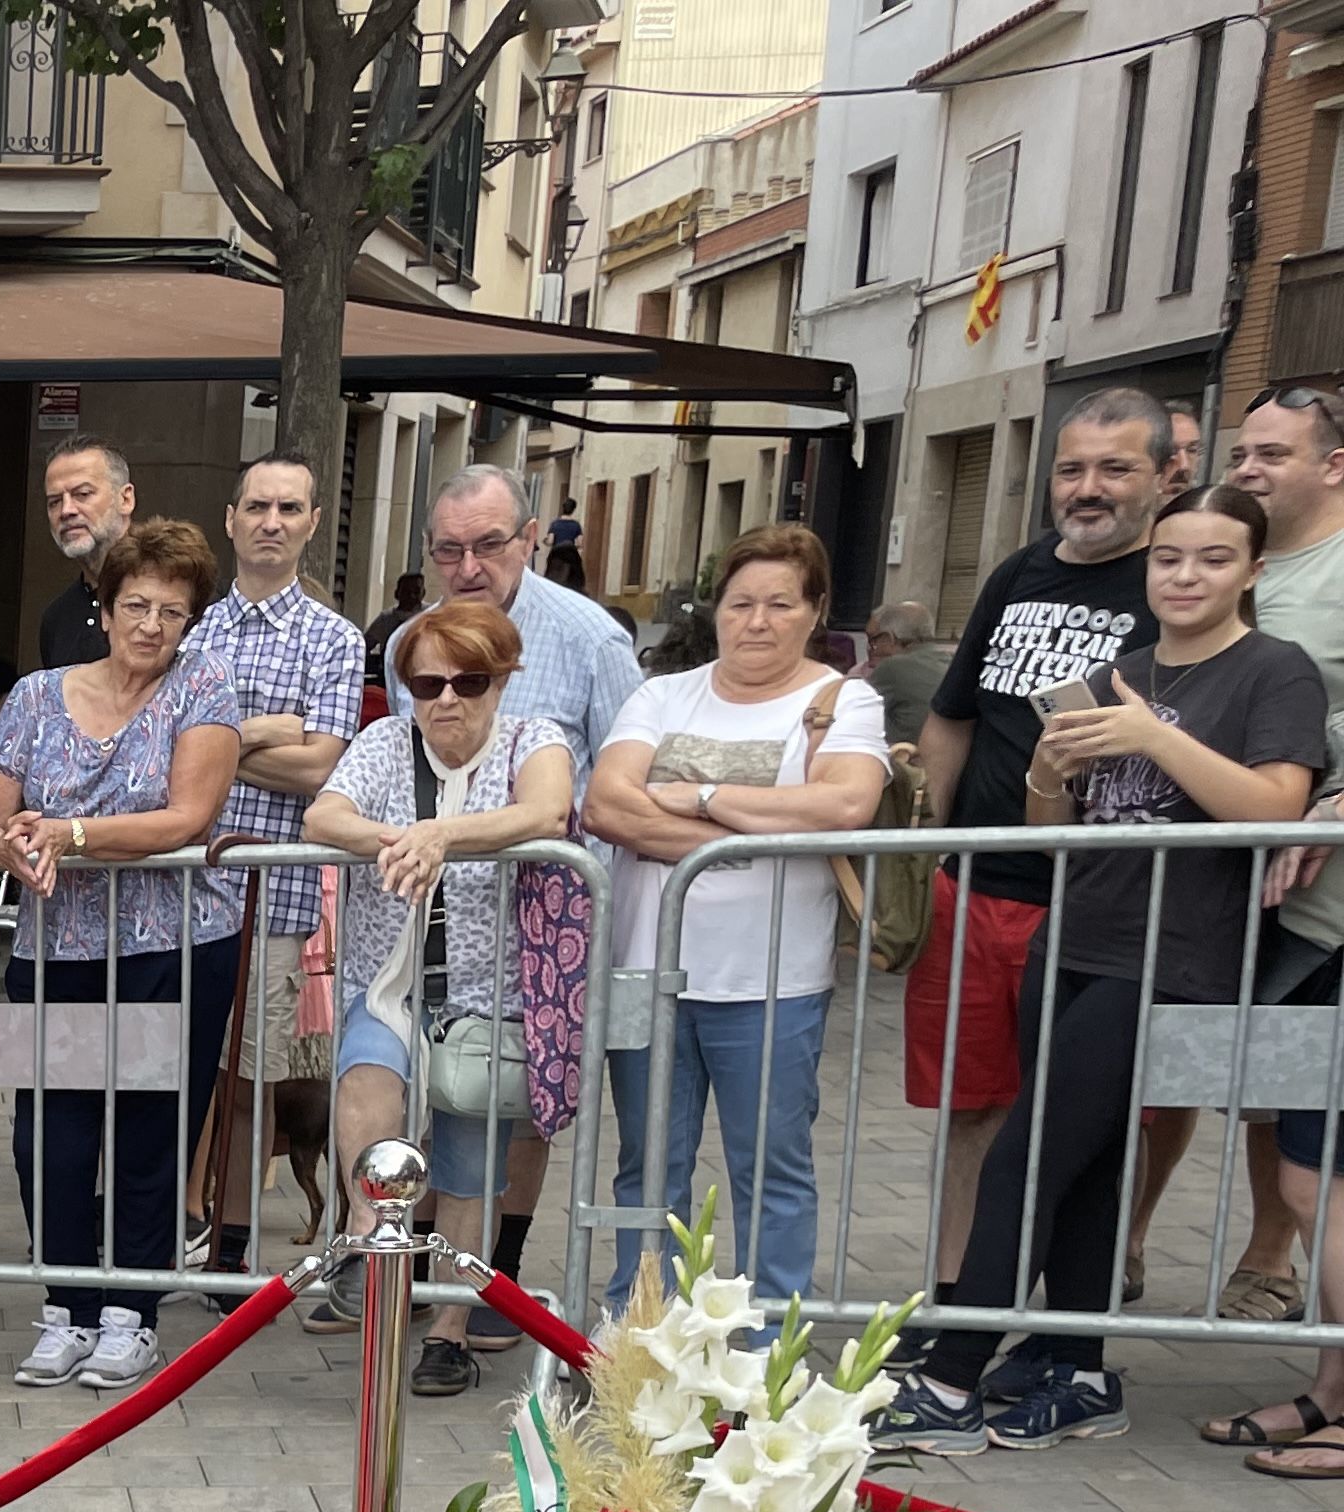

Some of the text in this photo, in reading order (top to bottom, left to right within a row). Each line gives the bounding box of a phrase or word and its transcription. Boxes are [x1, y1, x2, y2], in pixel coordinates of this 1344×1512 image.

[1000, 601, 1070, 629] WHEN
[998, 625, 1053, 651] FEEL
[1054, 628, 1123, 662] FEAR
[1025, 650, 1090, 680] FEED
